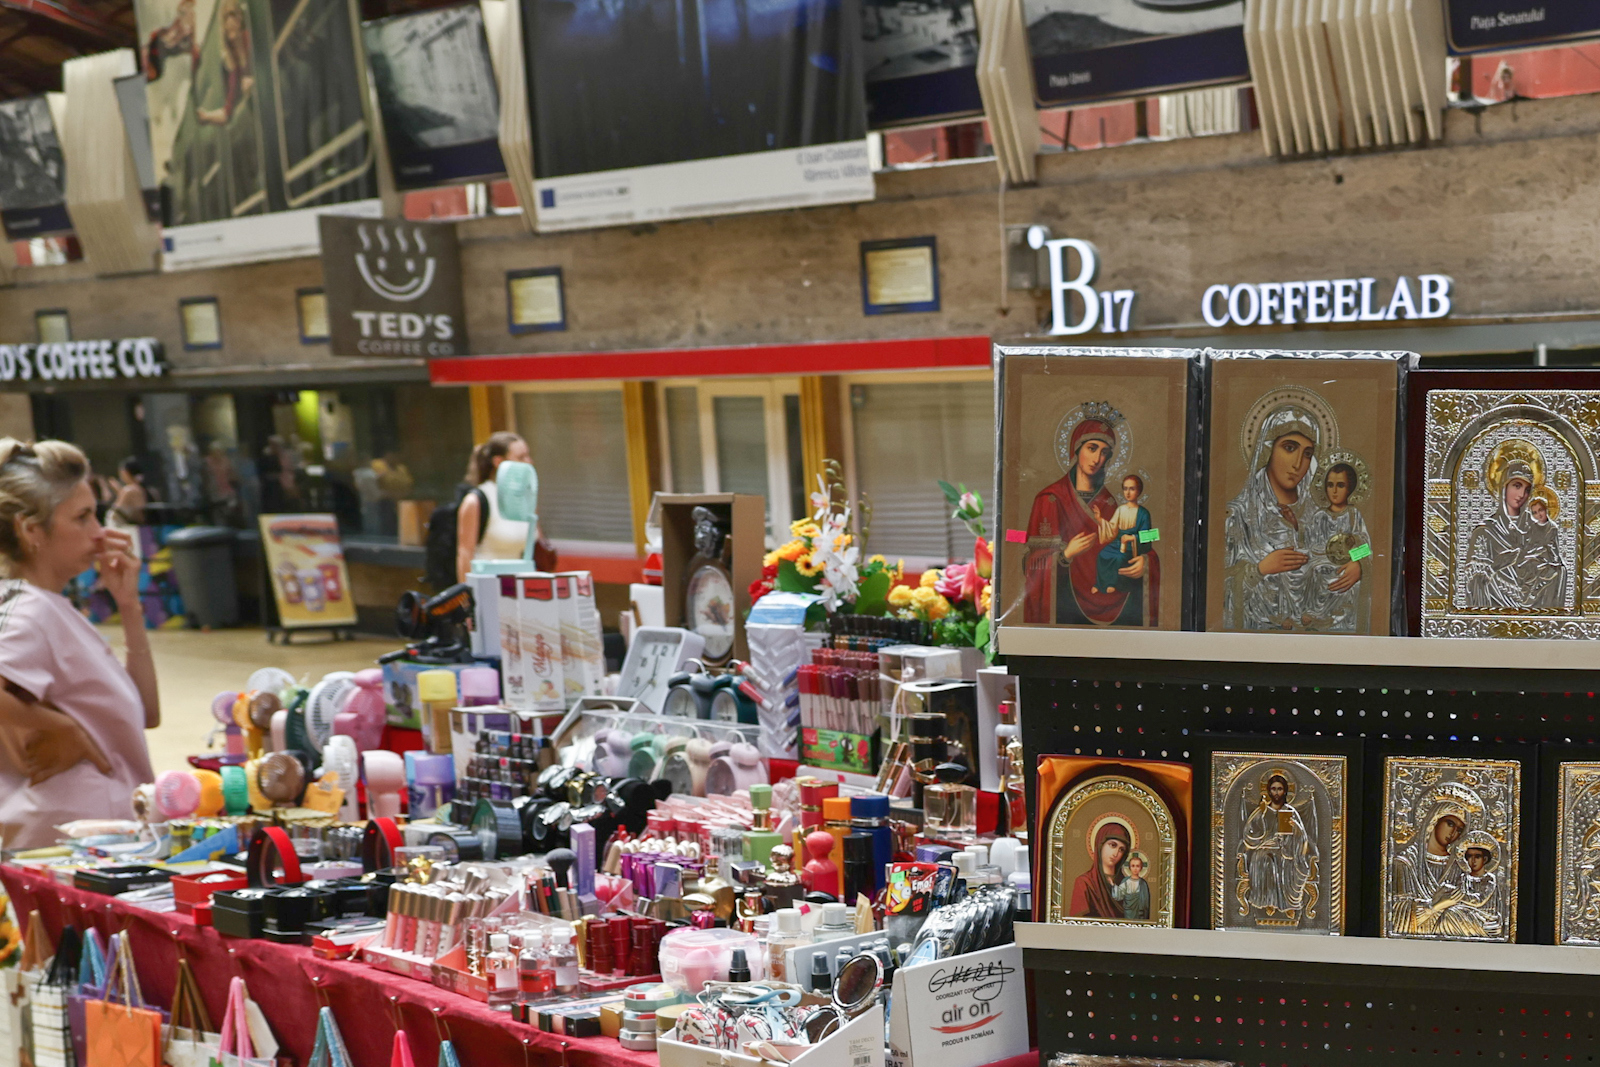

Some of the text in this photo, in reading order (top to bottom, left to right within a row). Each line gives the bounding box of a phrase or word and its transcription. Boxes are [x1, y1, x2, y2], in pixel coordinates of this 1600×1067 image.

[1201, 274, 1452, 328] COFFEELAB
[351, 311, 454, 340] TED'S
[357, 339, 422, 355] COFFEE
[0, 337, 162, 381] D'S COFFEE CO.
[935, 990, 963, 1001] ODORIZANT
[942, 1001, 991, 1023] air on
[941, 1029, 995, 1048] PRODUS IN ROMÂNIA
